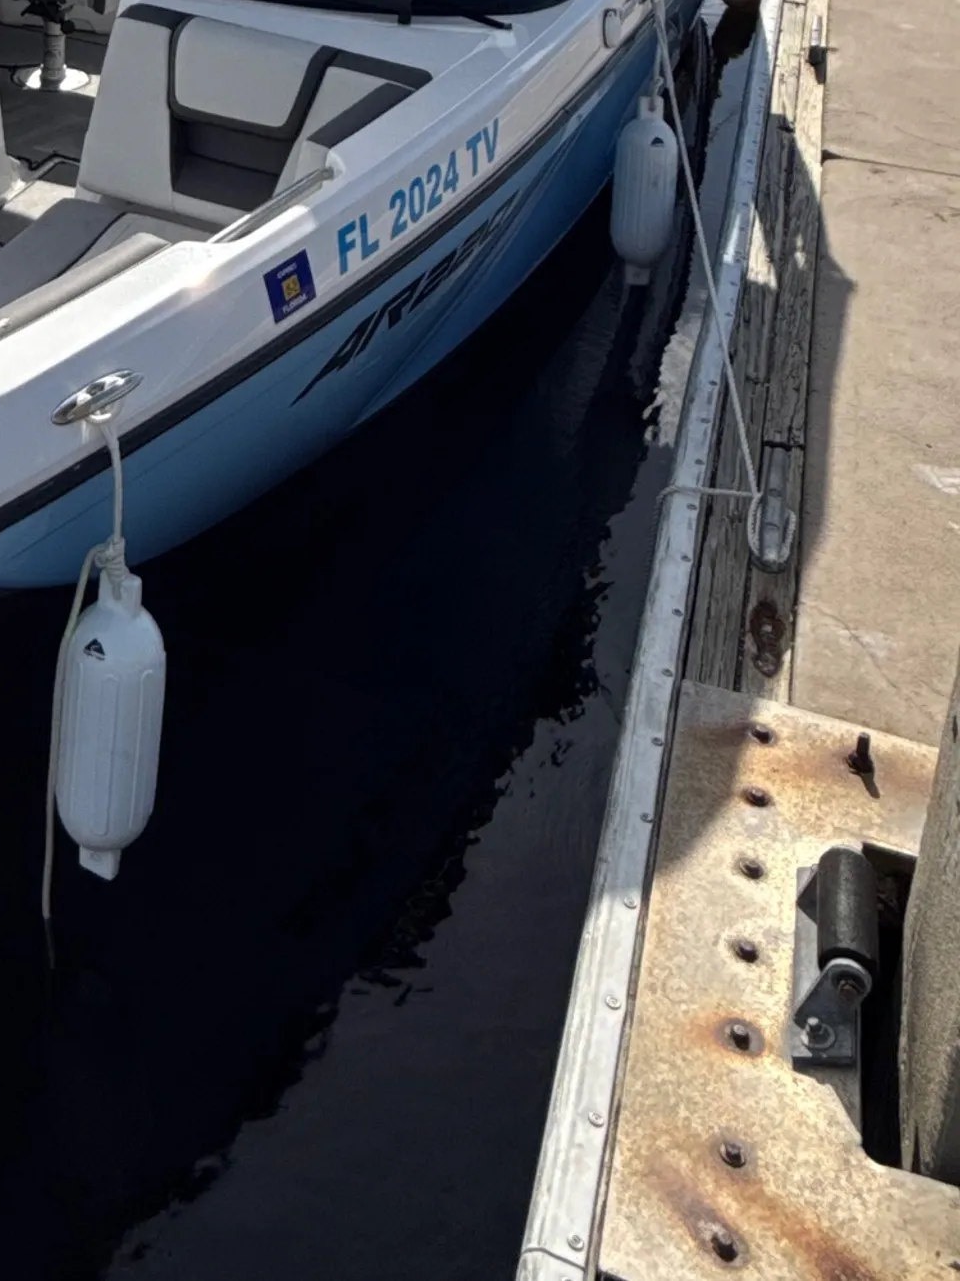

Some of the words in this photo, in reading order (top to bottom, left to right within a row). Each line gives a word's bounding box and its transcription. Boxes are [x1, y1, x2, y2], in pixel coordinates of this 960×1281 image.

[337, 213, 380, 275] FL
[389, 150, 460, 241] 2024
[466, 118, 500, 177] TV
